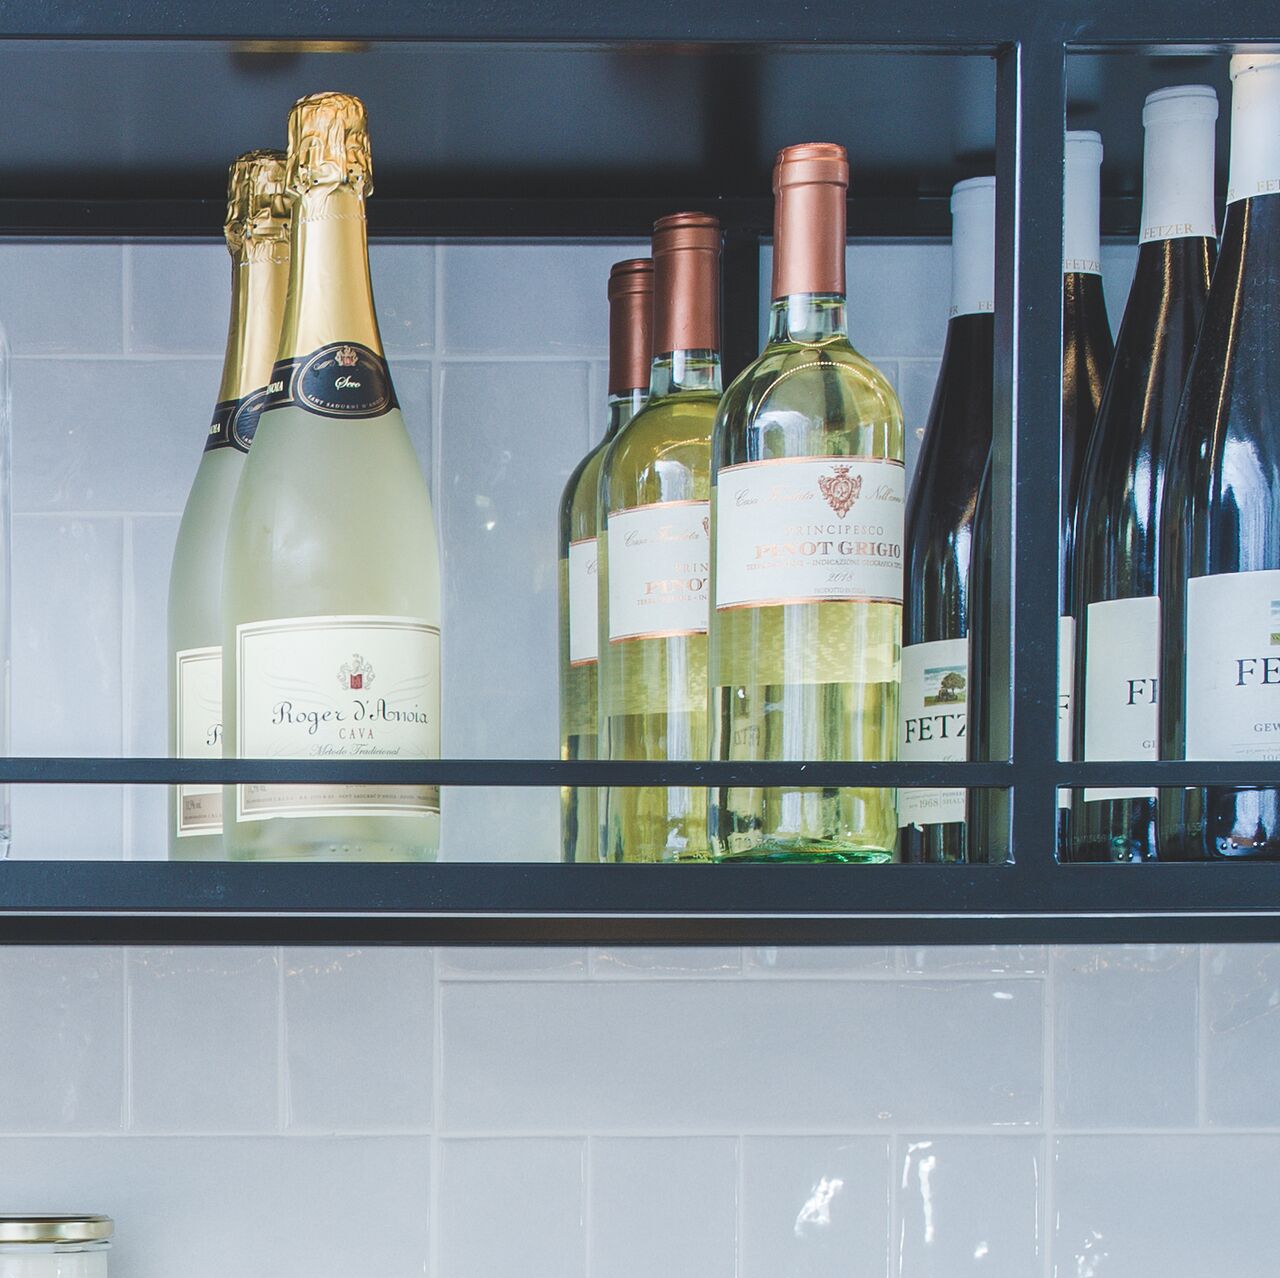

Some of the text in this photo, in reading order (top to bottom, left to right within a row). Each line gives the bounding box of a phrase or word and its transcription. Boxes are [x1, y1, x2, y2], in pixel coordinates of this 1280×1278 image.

[1143, 223, 1193, 239] FETZER
[755, 540, 901, 560] PINOT GRIGIO
[272, 700, 346, 736] Roger
[338, 727, 374, 740] CAVA
